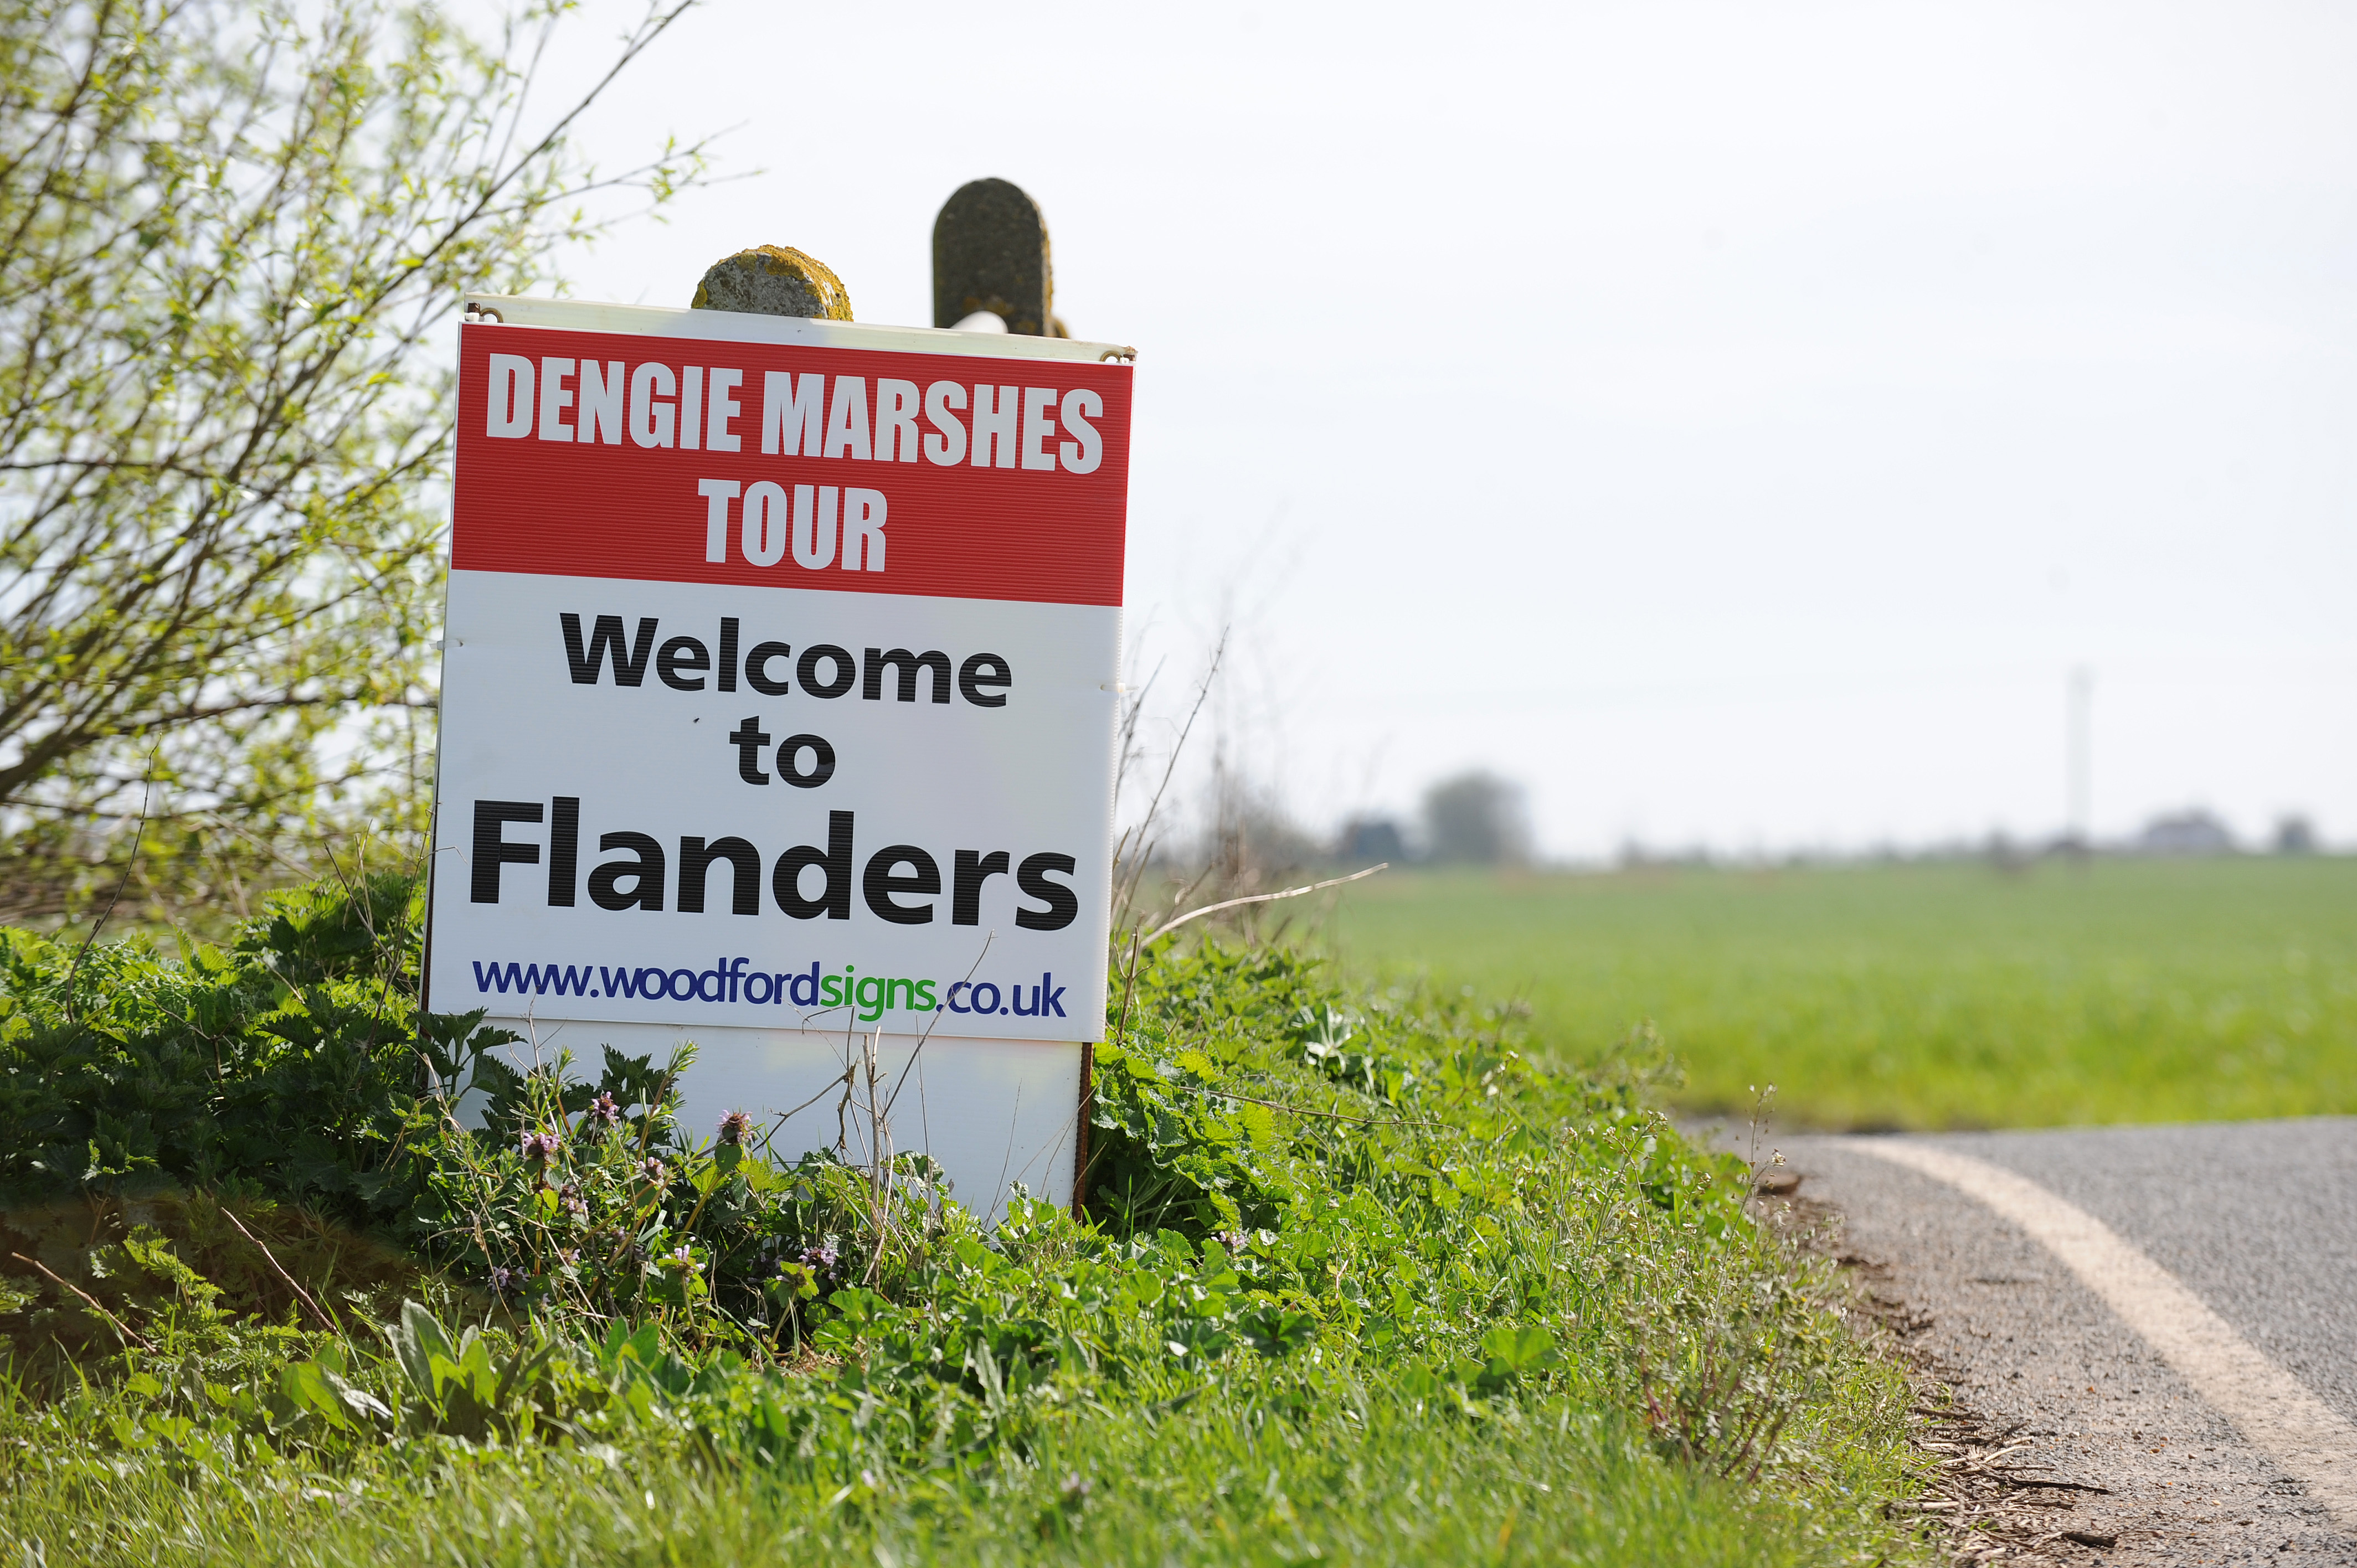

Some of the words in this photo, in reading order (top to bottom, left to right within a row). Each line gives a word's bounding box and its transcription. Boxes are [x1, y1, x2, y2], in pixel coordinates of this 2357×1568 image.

[486, 353, 743, 452] DENGIE
[761, 370, 1103, 474] MARSHES
[698, 478, 888, 572] TOUR
[559, 612, 1012, 708] Welcome
[729, 715, 836, 789] to
[470, 796, 1078, 931] Flanders
[472, 957, 1067, 1022] www.woodfordsigns.co.uk
